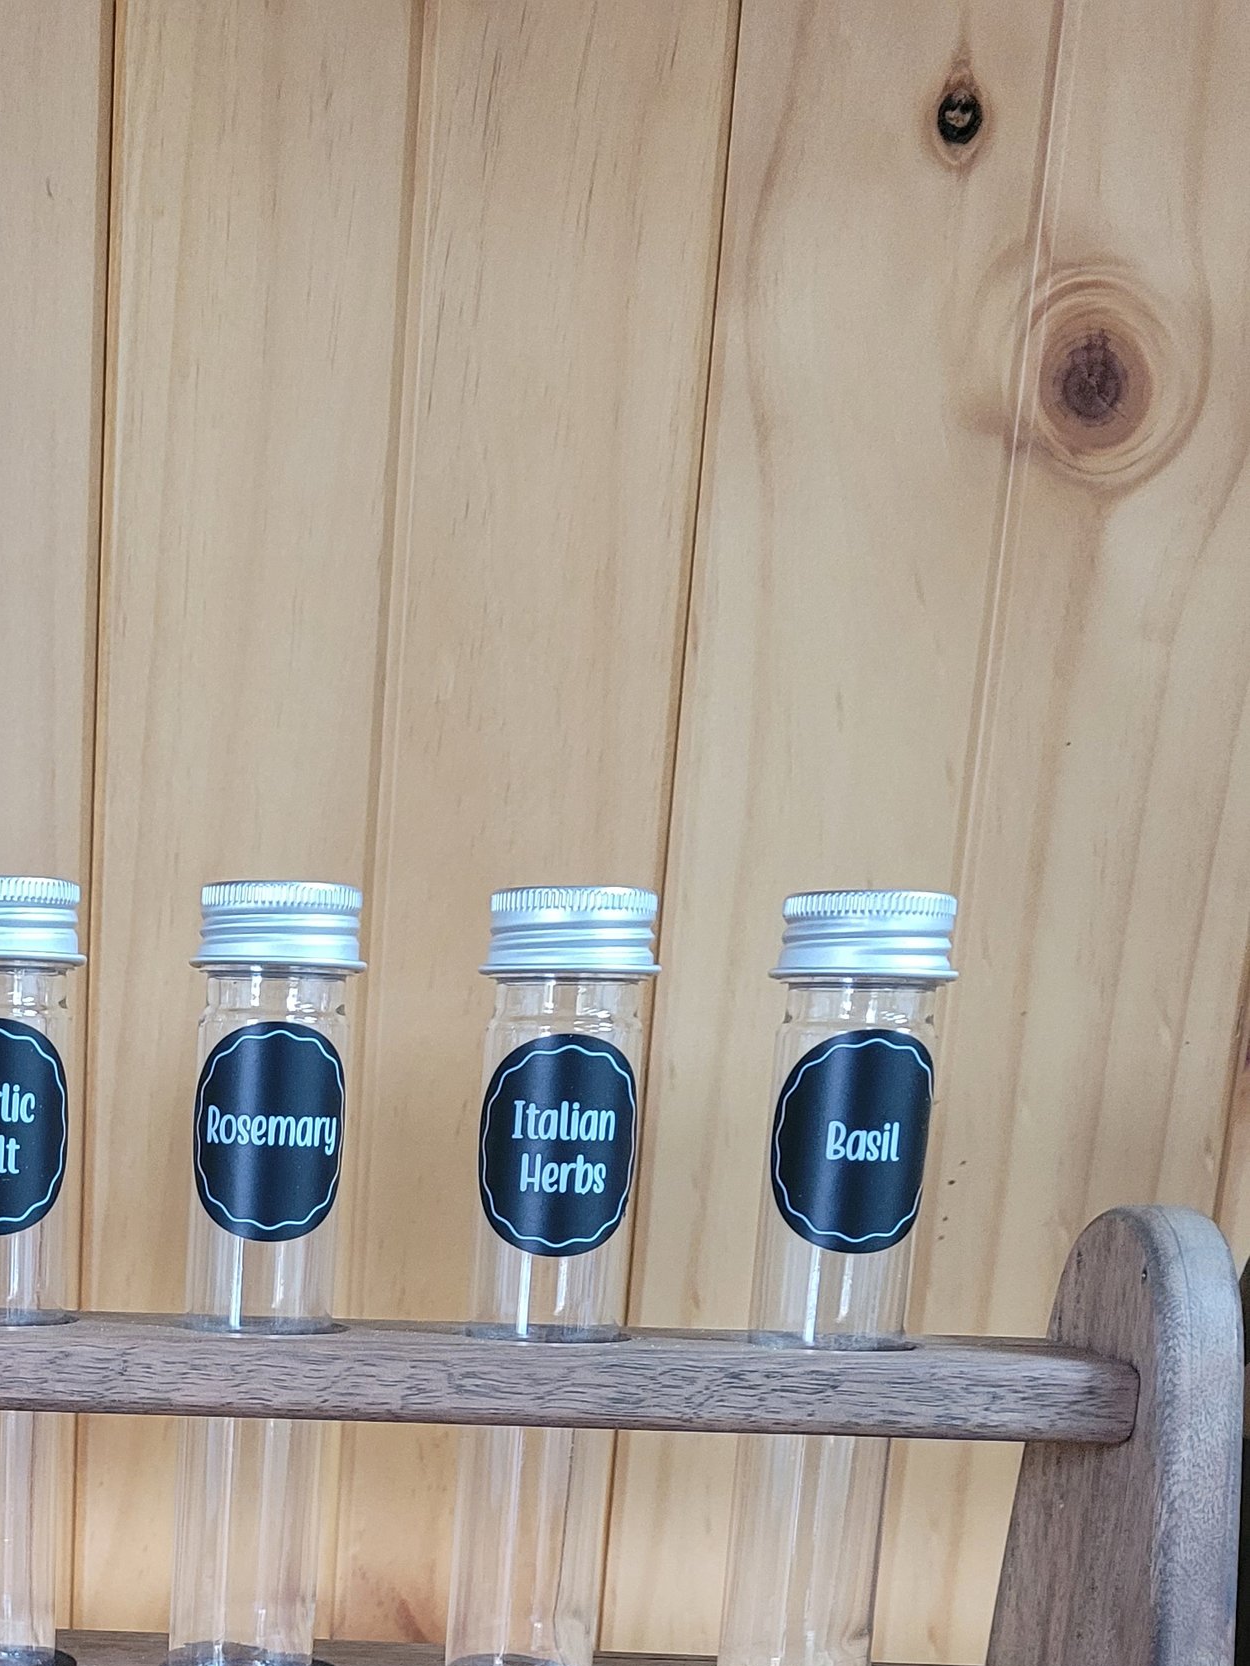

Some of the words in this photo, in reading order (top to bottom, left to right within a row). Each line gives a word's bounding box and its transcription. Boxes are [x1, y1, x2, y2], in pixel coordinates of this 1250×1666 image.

[206, 1104, 337, 1155] Rosemary
[511, 1100, 616, 1141] Italian
[826, 1120, 900, 1162] Basil
[519, 1153, 607, 1195] Herbs
